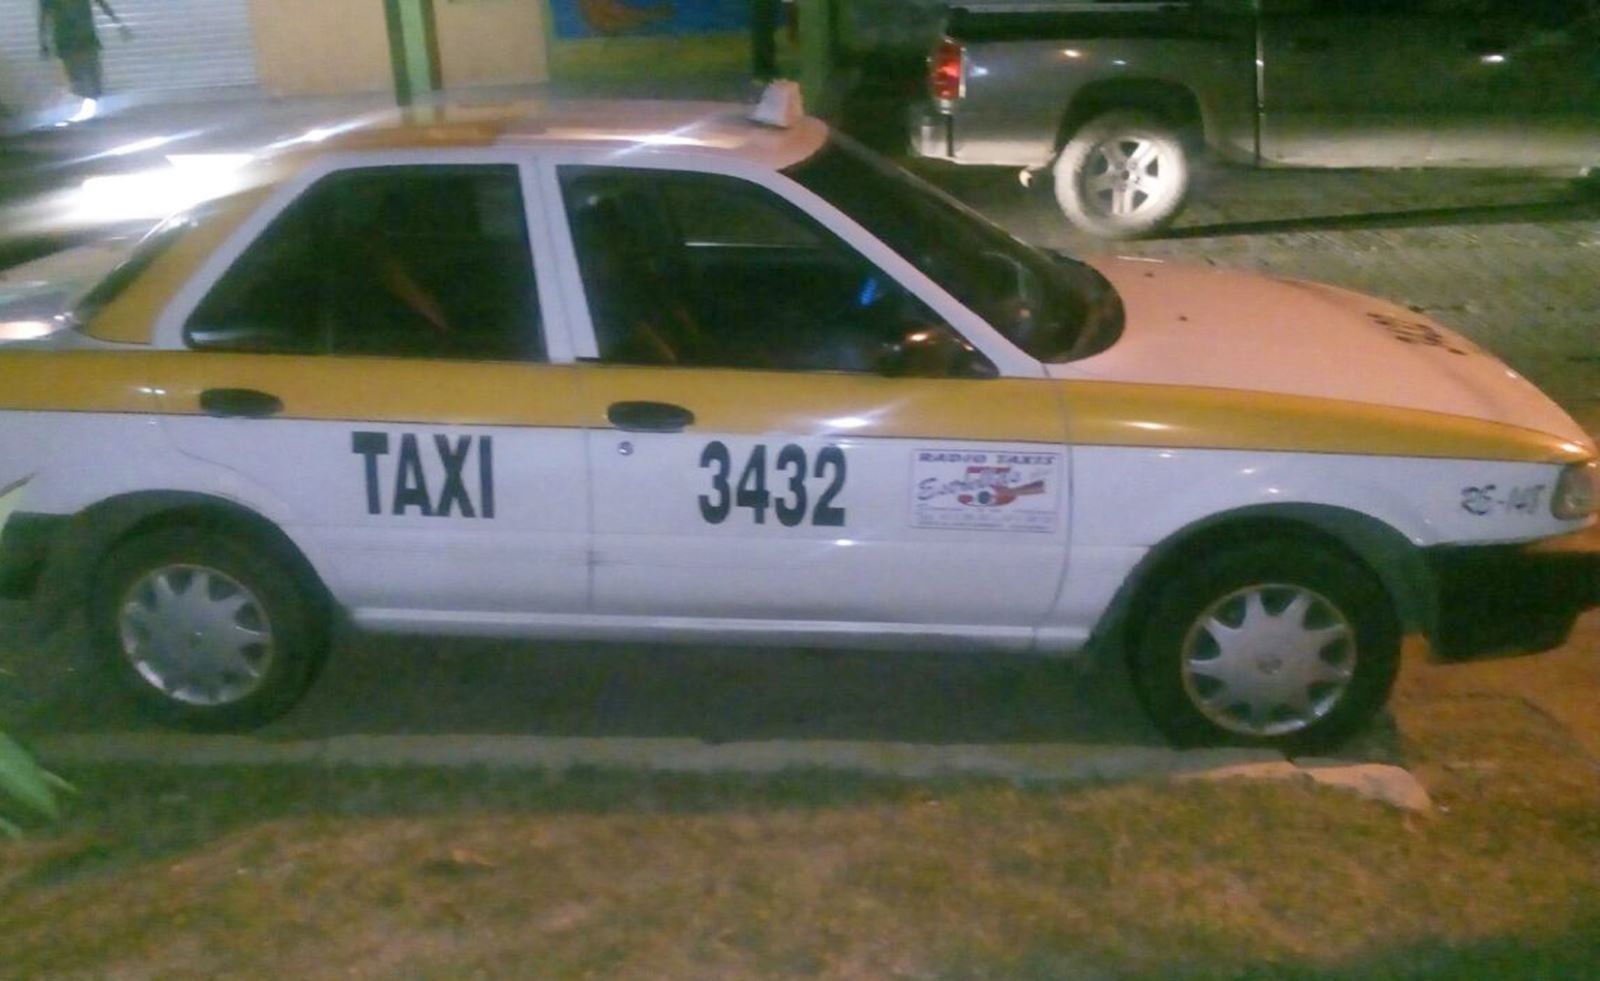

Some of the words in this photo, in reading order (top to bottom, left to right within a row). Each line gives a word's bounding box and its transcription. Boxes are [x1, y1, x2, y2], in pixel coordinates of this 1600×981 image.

[352, 431, 495, 518] TAXI
[698, 440, 846, 527] 3432
[918, 452, 987, 463] RADIO
